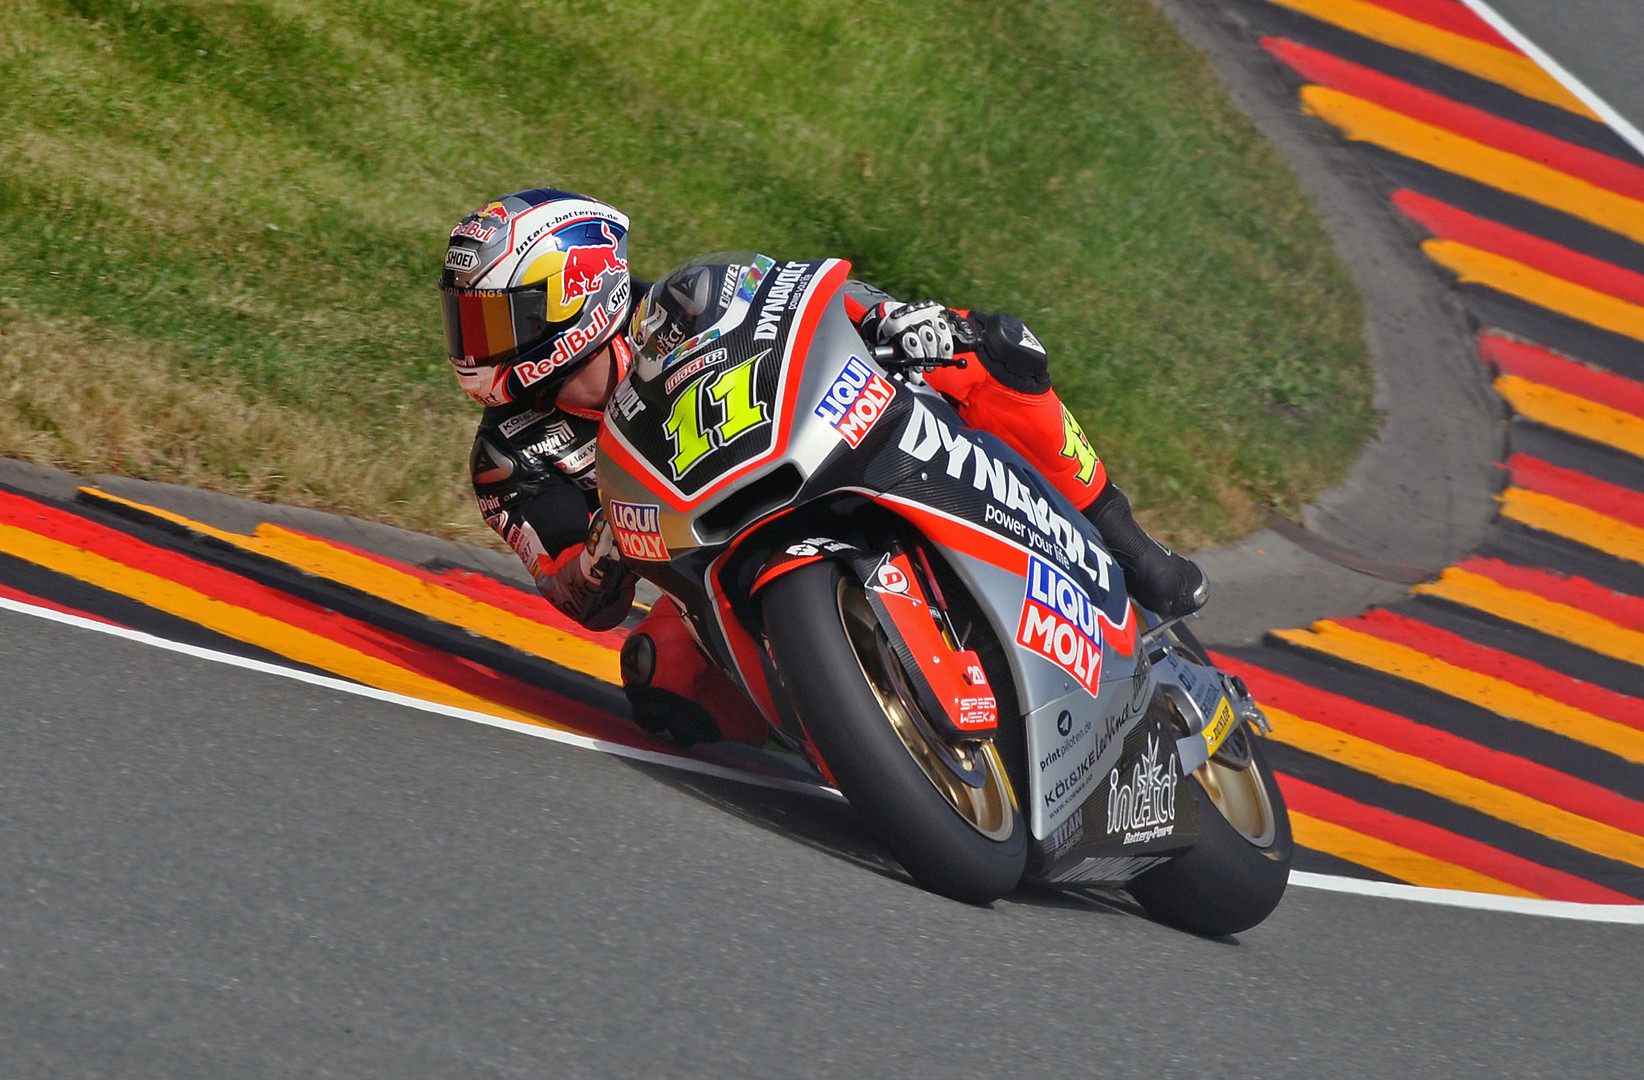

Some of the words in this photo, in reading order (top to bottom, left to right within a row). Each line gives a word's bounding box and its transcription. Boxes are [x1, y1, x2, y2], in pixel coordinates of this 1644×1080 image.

[446, 250, 474, 268] SHOEI
[464, 289, 503, 298] WINGS
[753, 261, 810, 341] DYNAVOLT
[662, 350, 772, 481] 11
[817, 360, 872, 426] LIQUI
[838, 375, 892, 444] MOLY
[522, 434, 561, 459] KUHN
[613, 505, 658, 533] LIQUI
[898, 397, 1113, 592] DYNAVOLT
[619, 533, 662, 558] MOLY
[985, 504, 1027, 537] power
[1028, 528, 1054, 556] your
[1054, 543, 1071, 570] life
[1032, 560, 1101, 646] LIQUI
[1022, 606, 1101, 689] MOLY
[960, 697, 997, 711] SPEED
[1040, 720, 1093, 772] printpiloten.de
